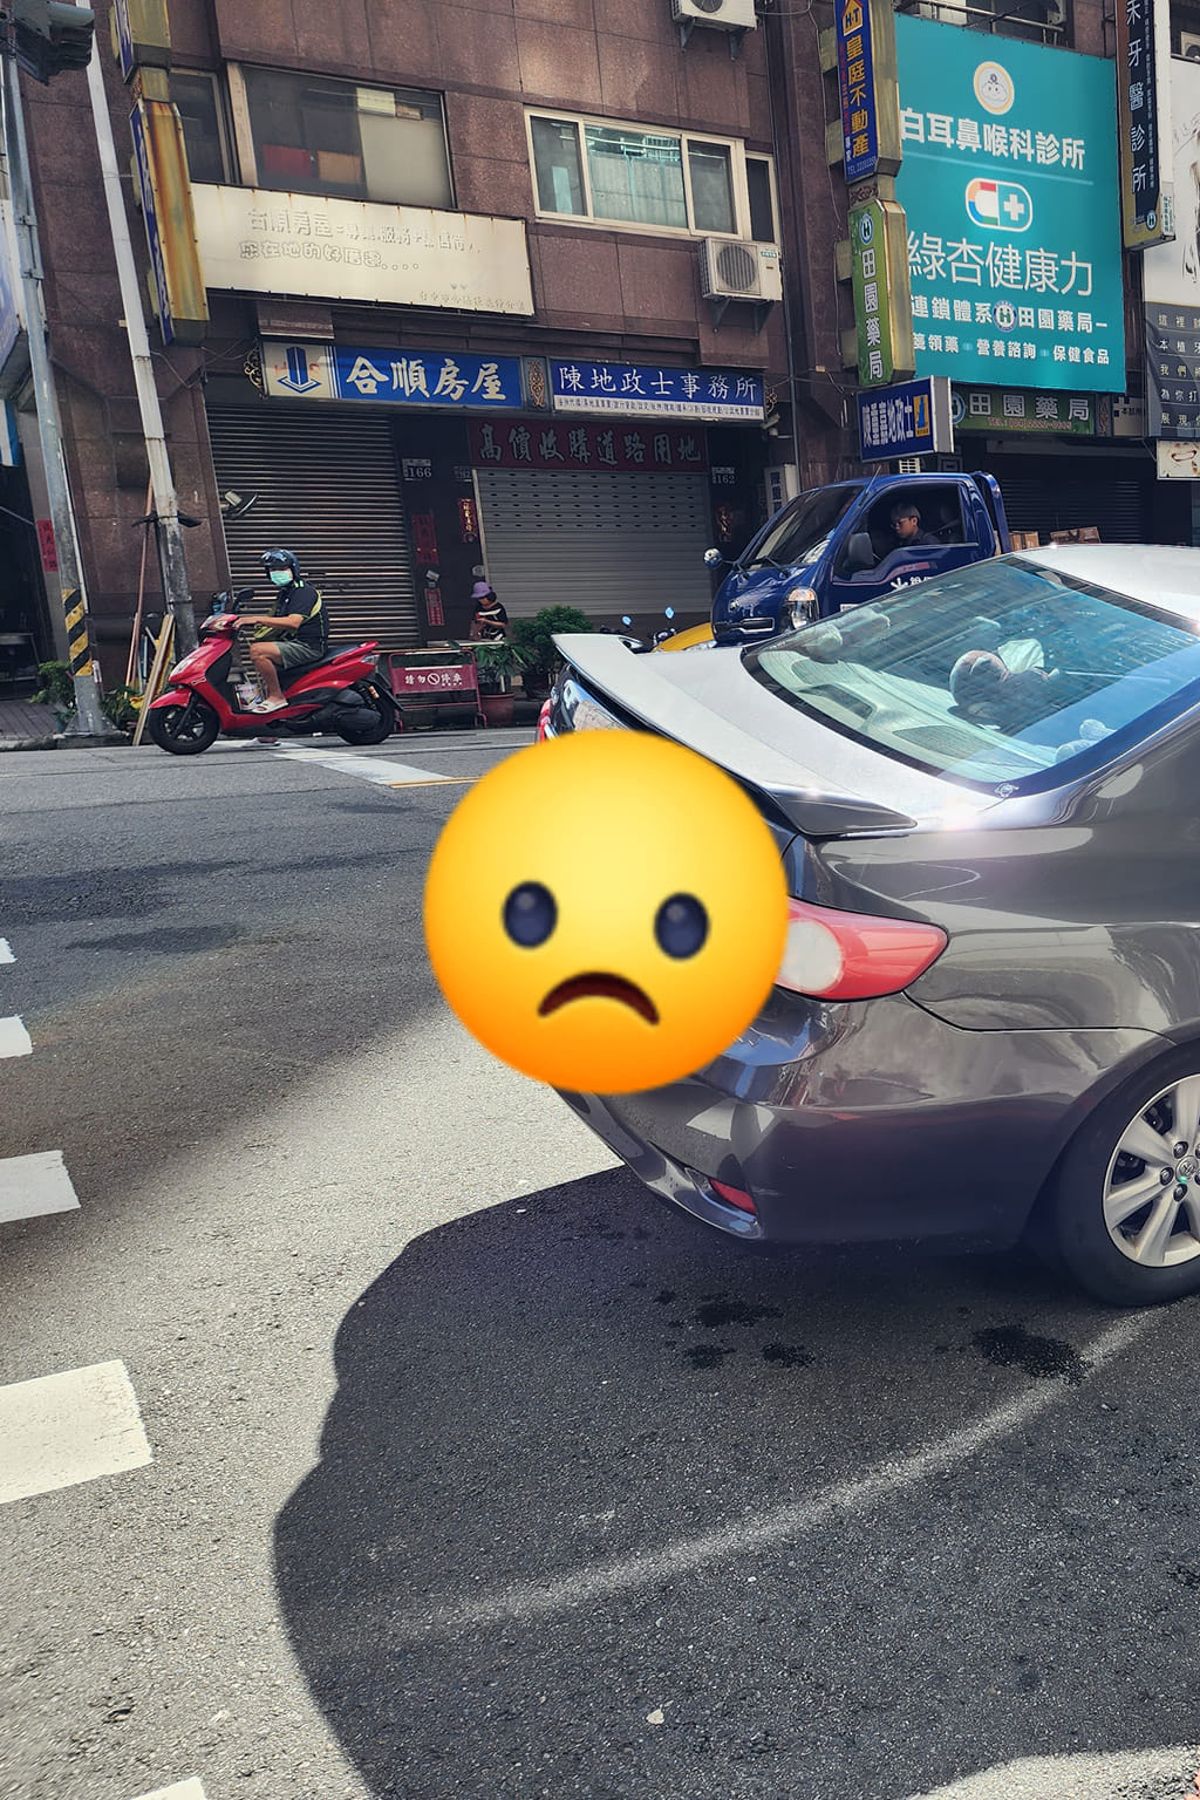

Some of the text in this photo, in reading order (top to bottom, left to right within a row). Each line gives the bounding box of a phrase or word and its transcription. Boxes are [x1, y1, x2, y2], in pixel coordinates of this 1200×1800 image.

[846, 34, 870, 159] 皇庭不動產
[899, 107, 1086, 171] 白耳鼻喉科診所
[907, 231, 1093, 297] 綠杏健康力
[861, 248, 884, 380] 田園藥局
[911, 294, 993, 324] 連鎖體系
[976, 338, 1037, 360] 營養諮詢
[1052, 345, 1110, 365] 保健食品
[346, 355, 507, 401] 合順房屋
[558, 365, 758, 401] 陳地政士事務所
[969, 392, 1090, 421] 田園藥局
[479, 423, 701, 466] 高價收購道路用地
[407, 466, 432, 478] 166
